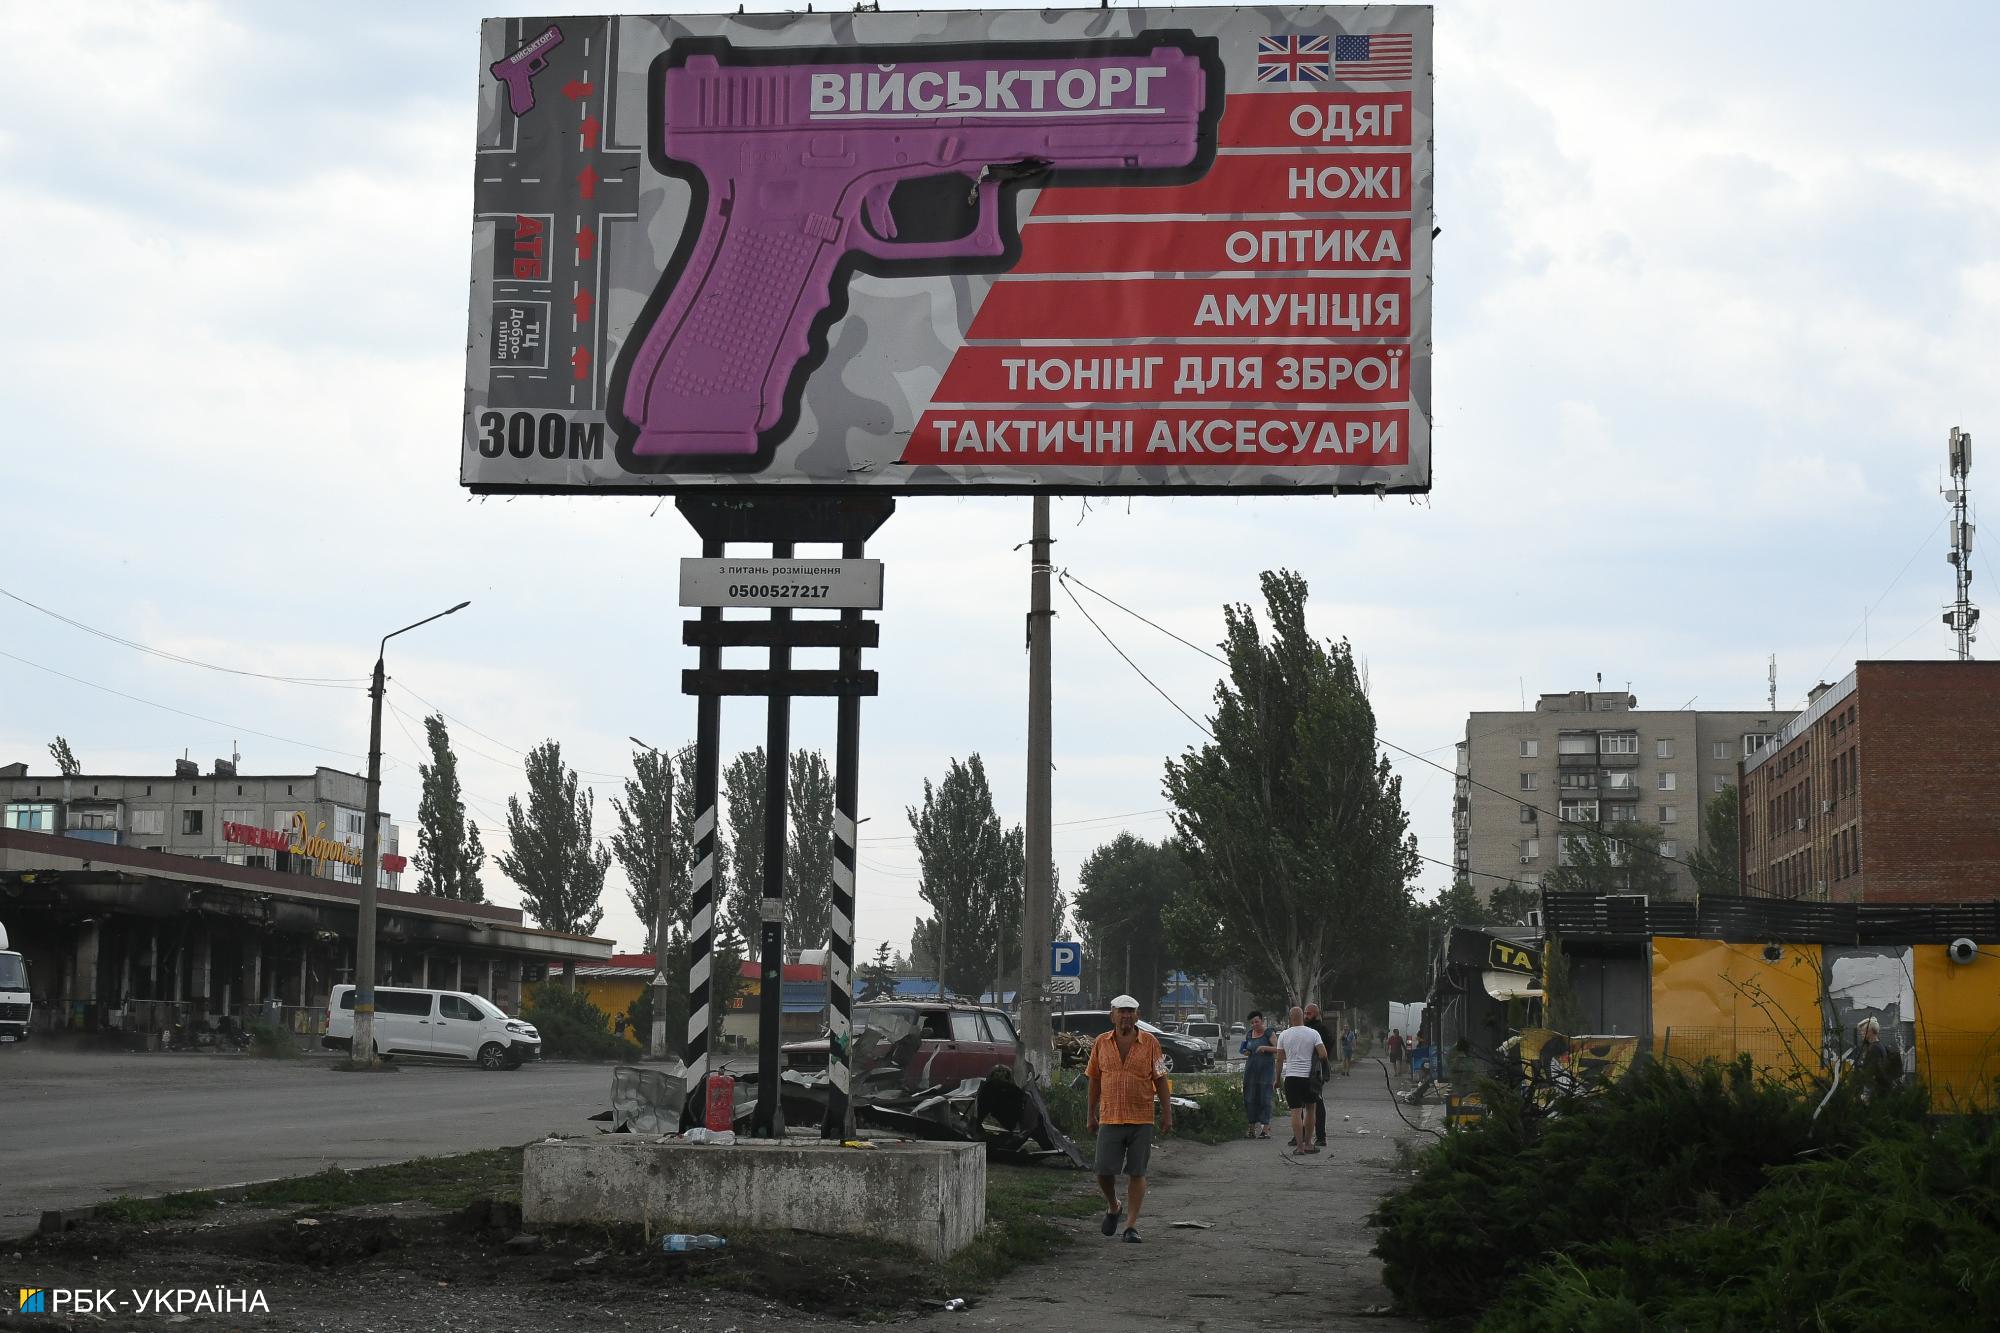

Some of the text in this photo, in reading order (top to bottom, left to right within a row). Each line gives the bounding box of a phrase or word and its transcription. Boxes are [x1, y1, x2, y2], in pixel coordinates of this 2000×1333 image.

[810, 63, 1167, 112] ВІЙСЬКТОРГ
[1289, 104, 1403, 142] ОДЯГ
[1288, 167, 1401, 199] НОЖІ
[512, 214, 544, 281] АТБ
[1225, 229, 1402, 264] ОПТИКА
[1193, 293, 1400, 332] АМУНІЦІЯ
[497, 321, 509, 360] пілля
[510, 308, 525, 360] Добро-
[522, 321, 540, 347] ТЦ
[1001, 349, 1403, 395] ТЮНІНГ ДЛЯ ЗБРОЇ
[932, 420, 1398, 454] ТАКТИЧНІ АКСЕСУАРИ
[719, 566, 841, 577] з питань розміщення
[728, 585, 830, 598] 0500527217
[1055, 947, 1074, 972] P
